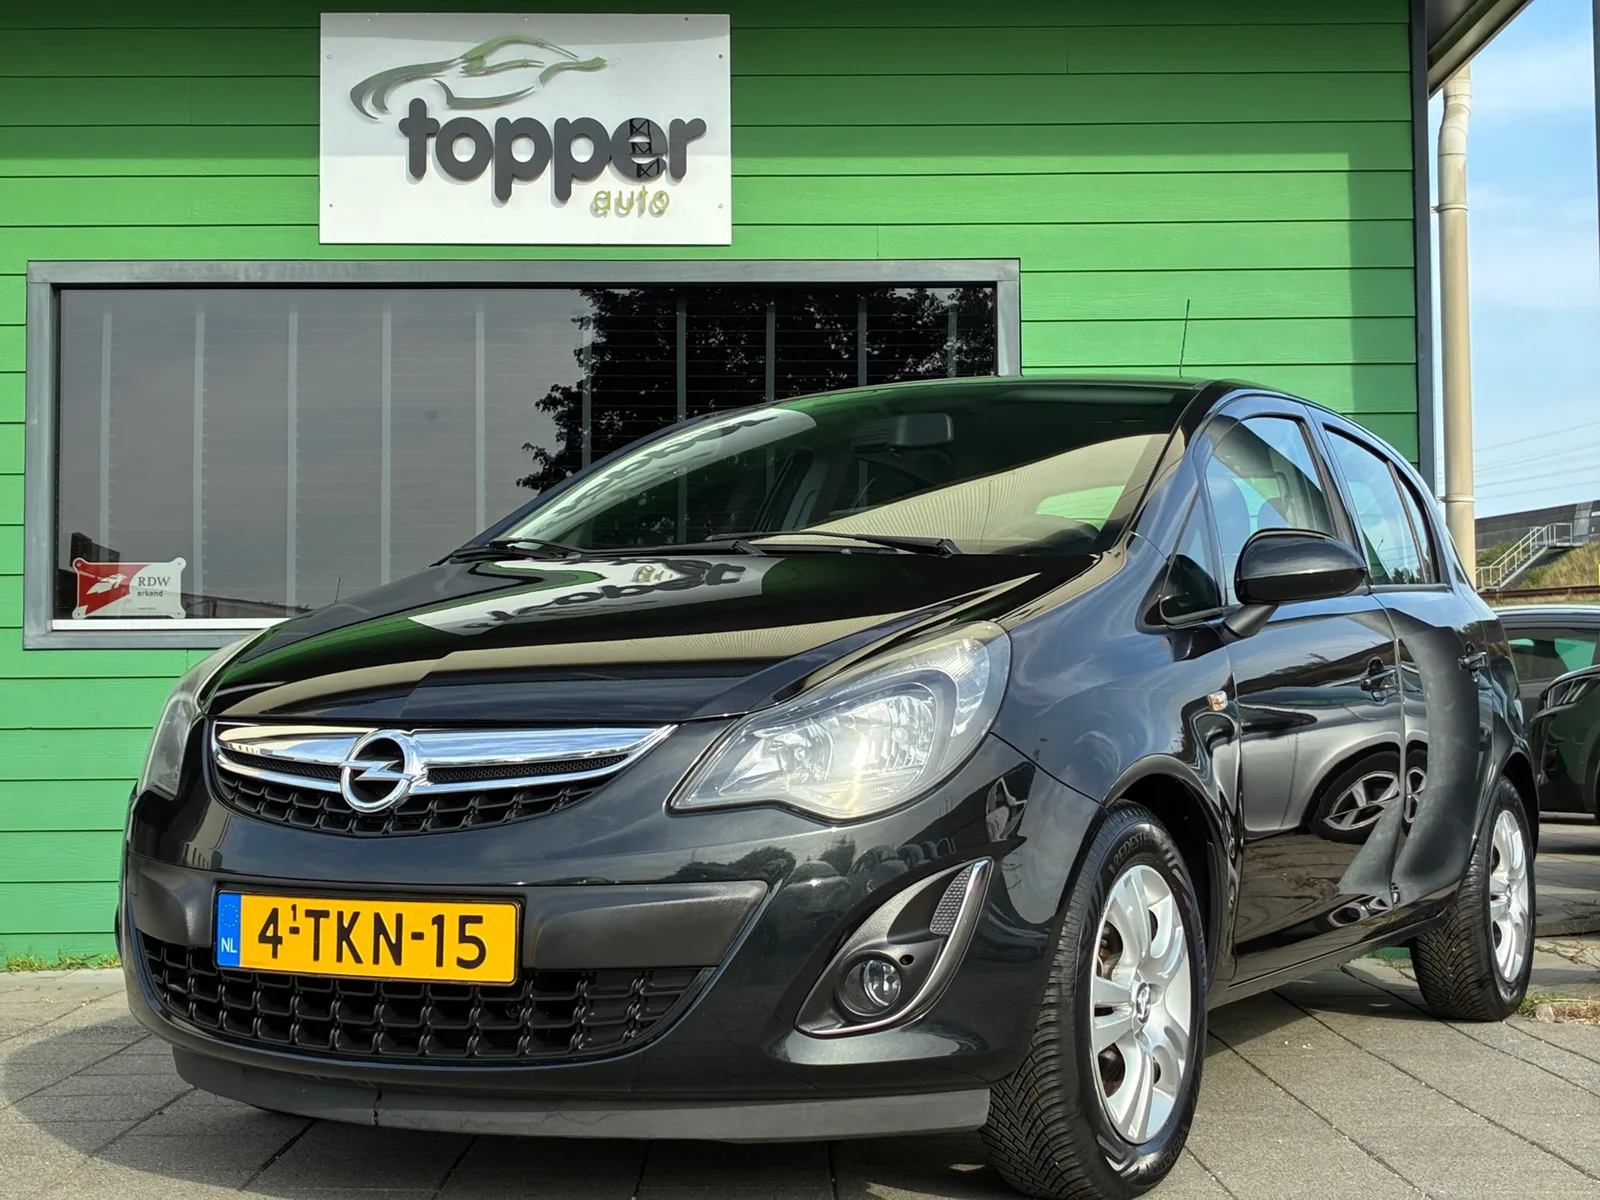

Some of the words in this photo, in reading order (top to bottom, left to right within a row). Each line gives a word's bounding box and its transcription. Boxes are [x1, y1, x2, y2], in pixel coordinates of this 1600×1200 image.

[399, 97, 707, 204] topper
[593, 185, 670, 213] auto
[138, 576, 171, 587] RDW
[137, 589, 163, 597] erkend
[221, 936, 238, 954] NL
